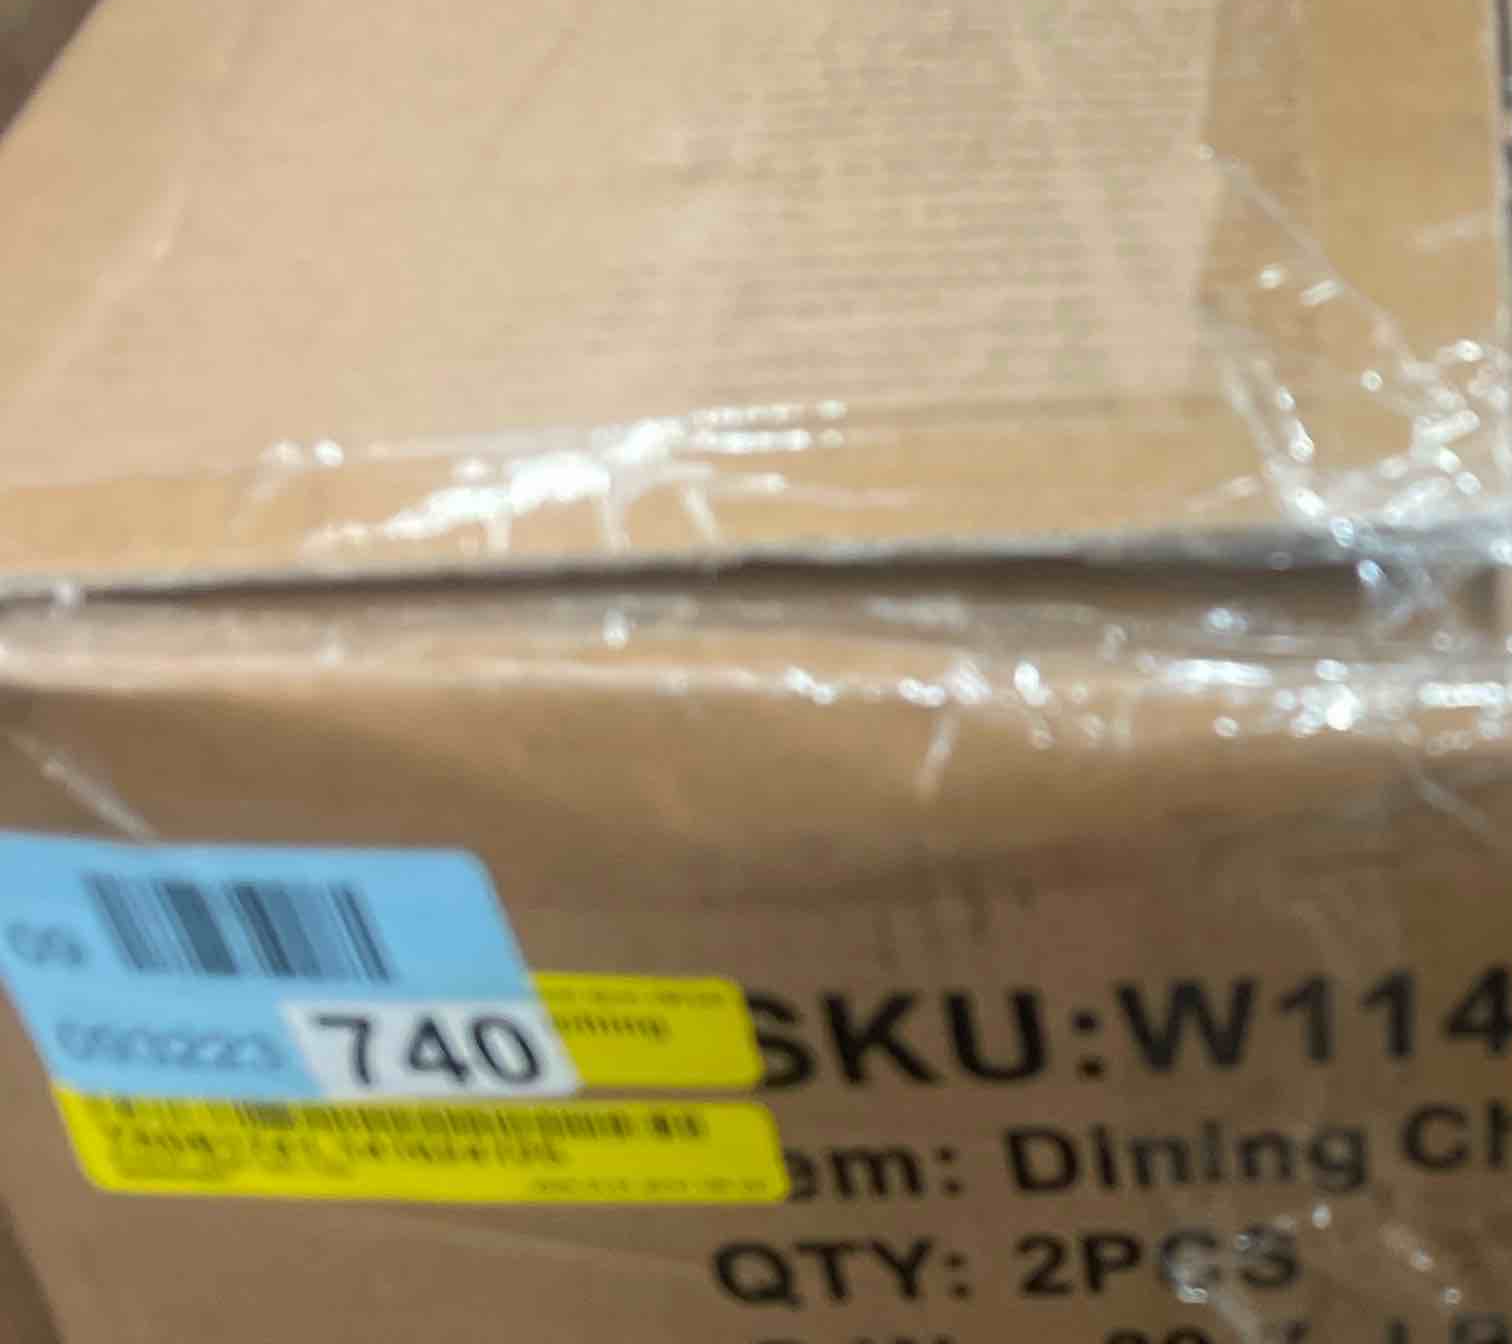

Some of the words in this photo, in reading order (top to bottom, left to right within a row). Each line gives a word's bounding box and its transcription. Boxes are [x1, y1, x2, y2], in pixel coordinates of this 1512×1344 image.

[314, 1012, 544, 1086] 740
[1004, 1119, 1369, 1199] Dining
[712, 1237, 971, 1310] QTY:
[1015, 1226, 1303, 1299] 2PCS
